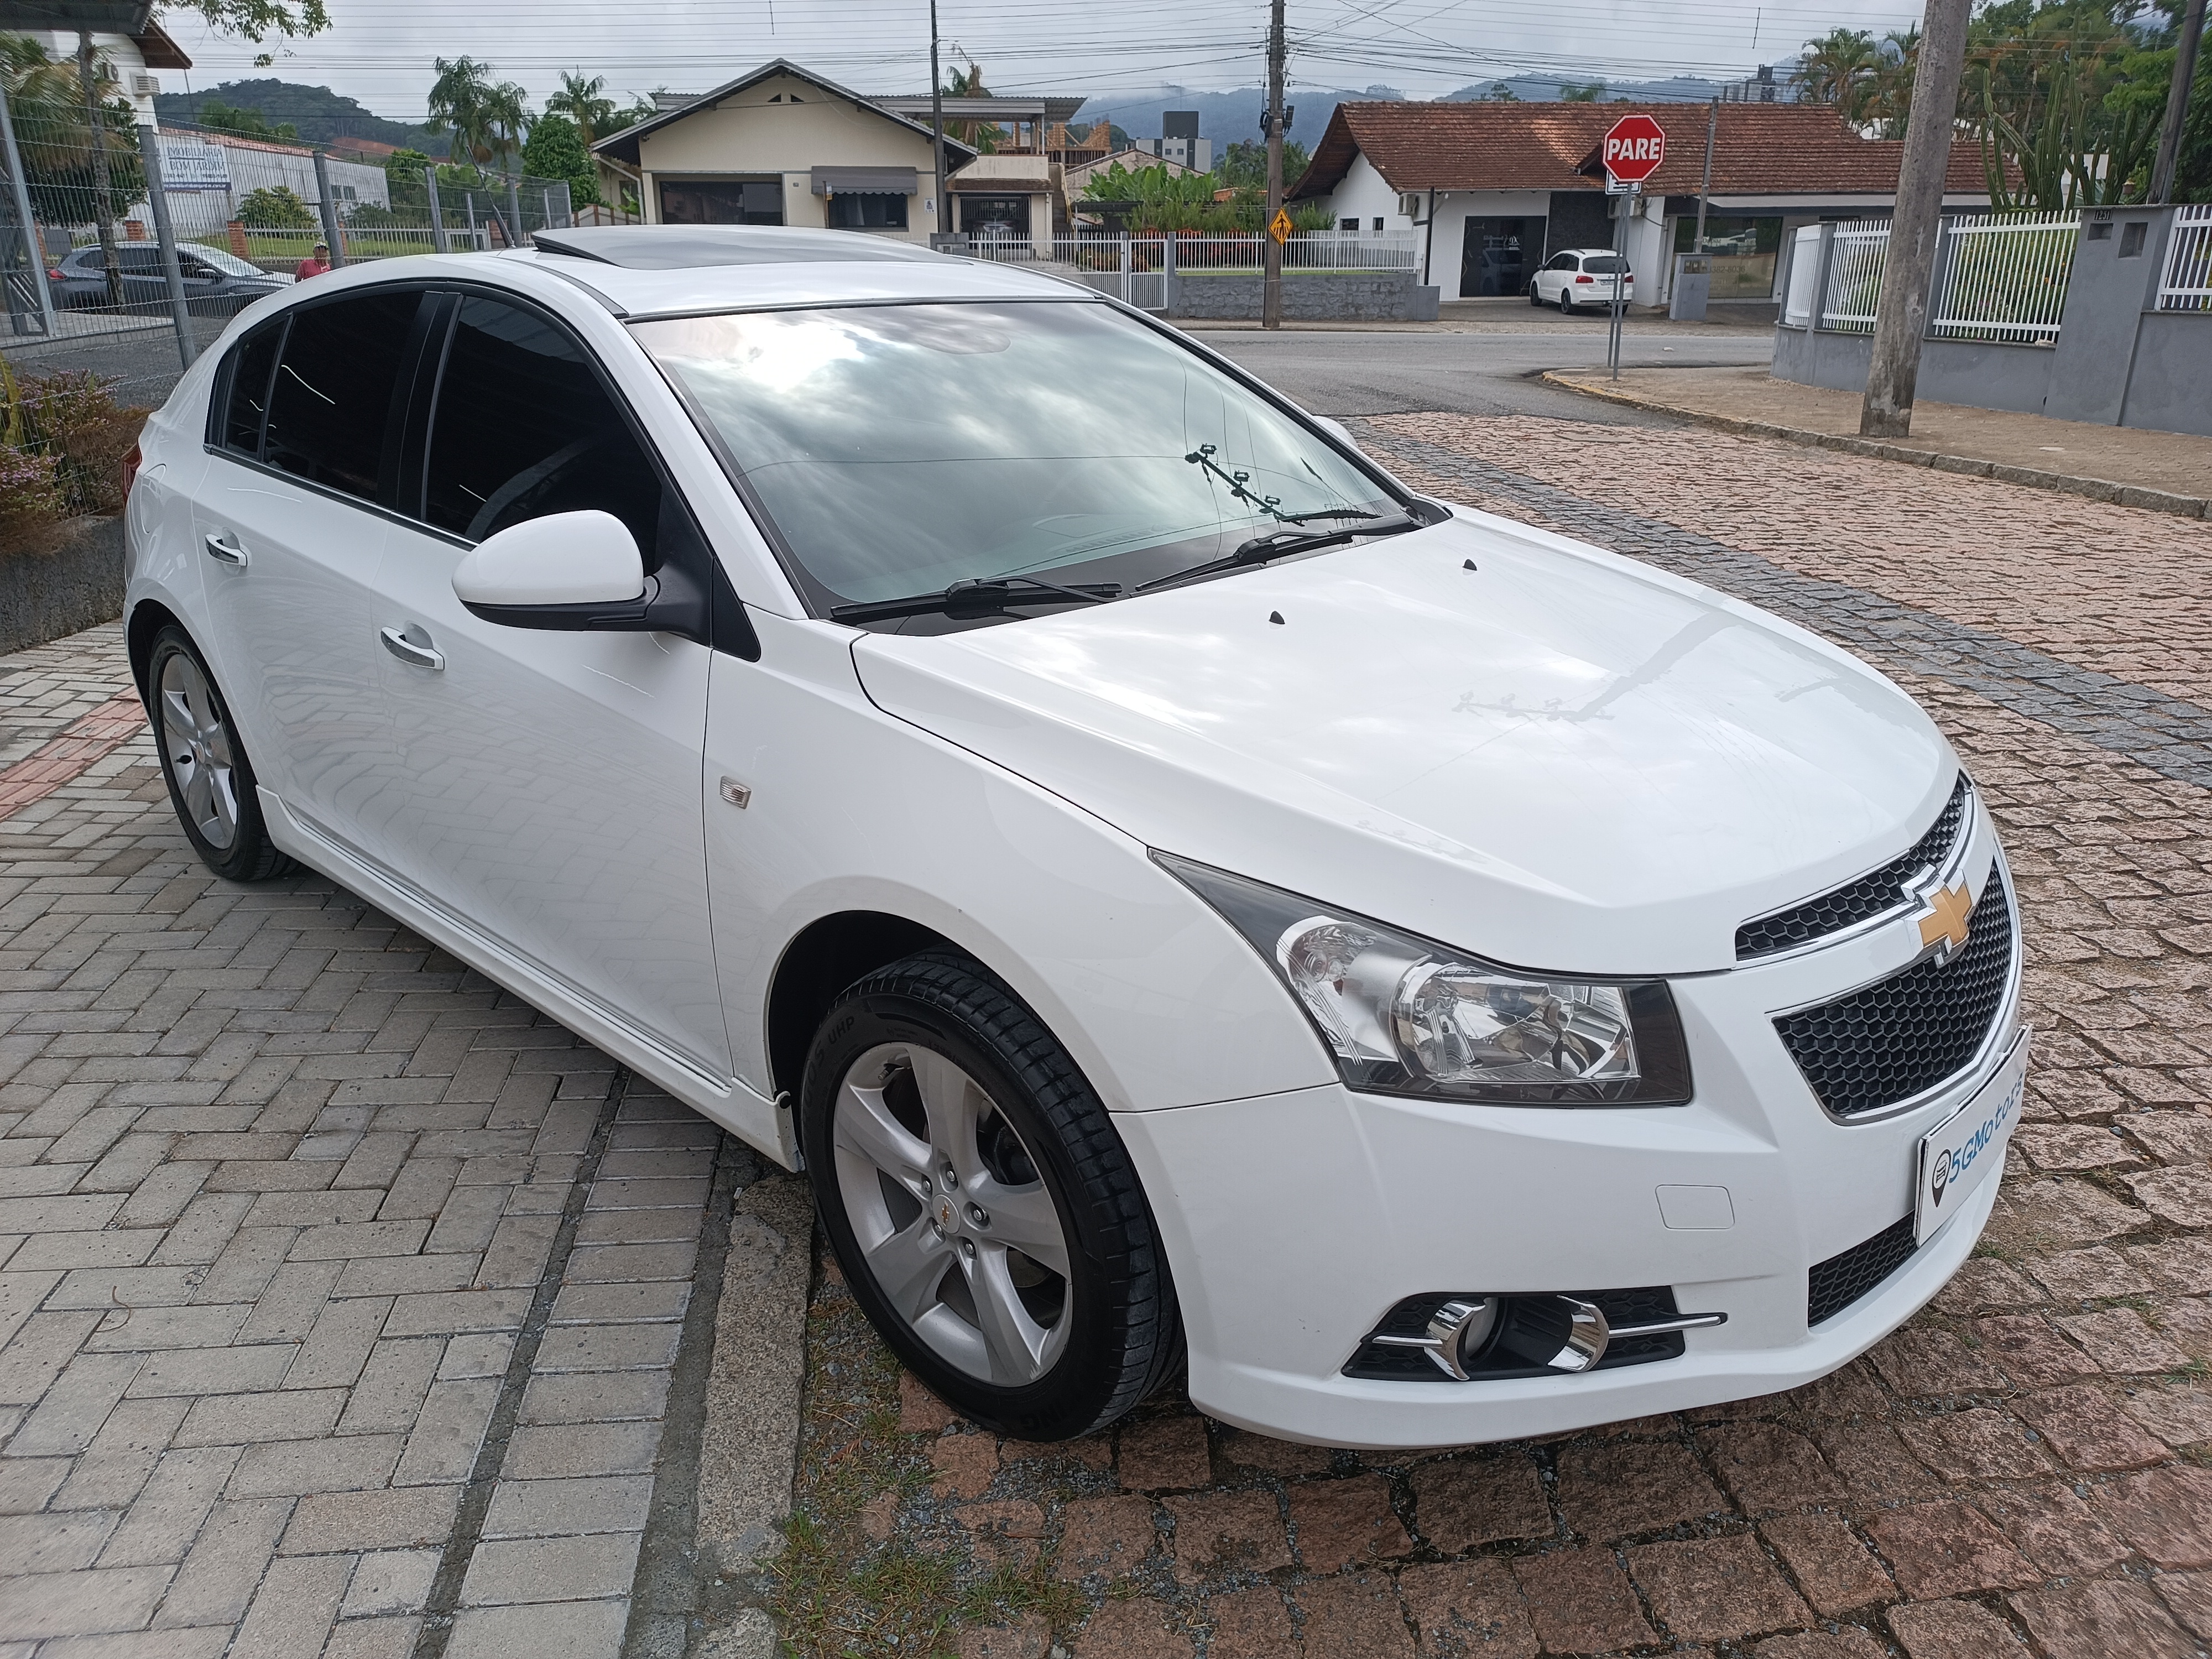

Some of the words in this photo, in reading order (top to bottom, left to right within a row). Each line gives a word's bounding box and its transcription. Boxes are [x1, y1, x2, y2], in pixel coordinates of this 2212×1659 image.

[1607, 137, 1661, 160] PARE
[170, 160, 190, 170] BOM
[827, 1015, 855, 1045] UHP
[1948, 1072, 2023, 1183] 5GMotors
